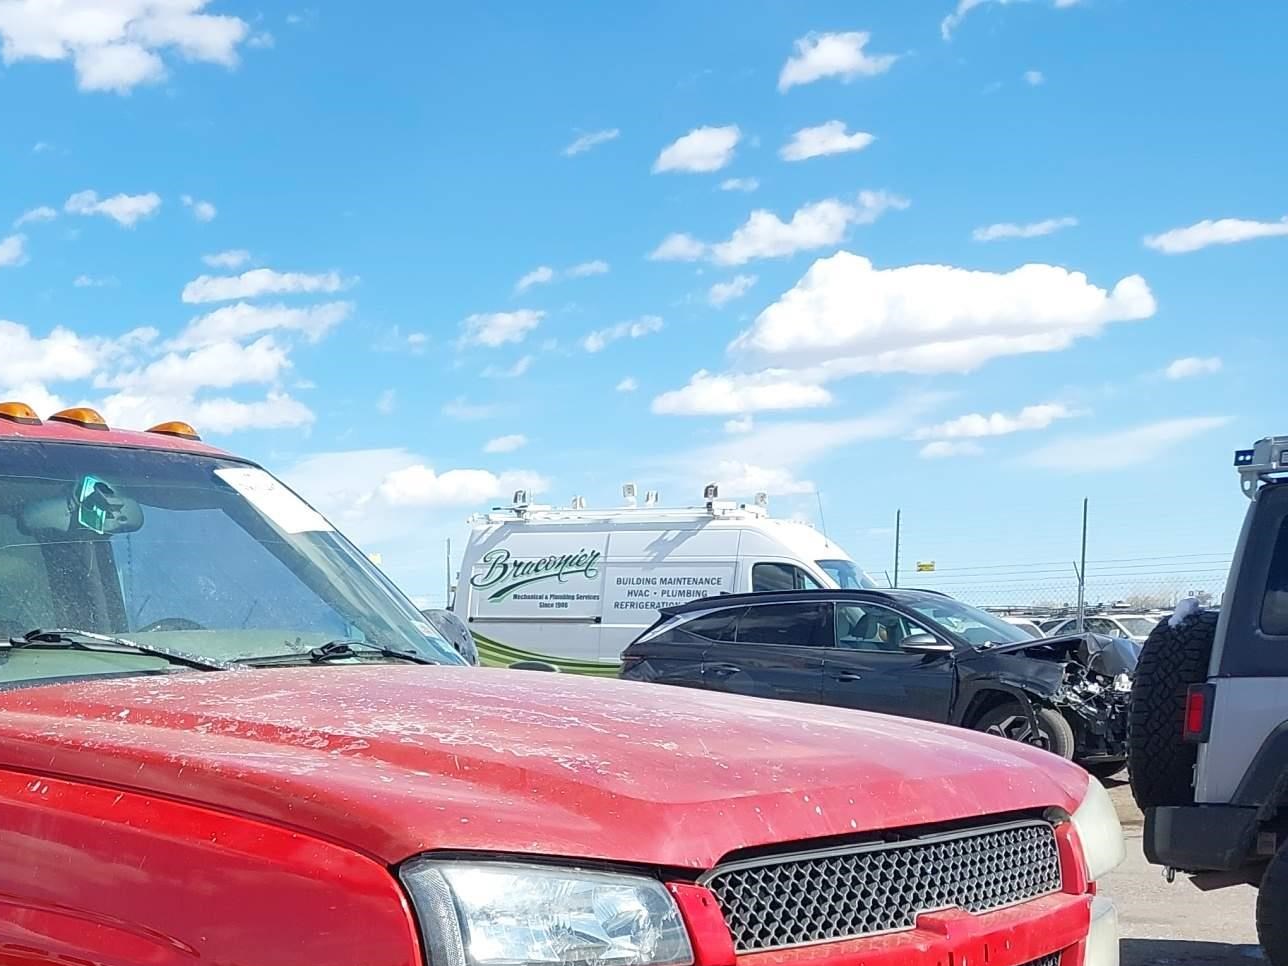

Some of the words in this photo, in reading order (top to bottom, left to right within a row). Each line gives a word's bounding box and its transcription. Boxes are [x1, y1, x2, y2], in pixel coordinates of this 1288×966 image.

[470, 548, 600, 588] Braconier
[616, 577, 657, 586] BUILDING
[659, 577, 723, 586] MAINTENANCE
[627, 589, 650, 598] HVAC
[661, 589, 708, 598] PLUMBING
